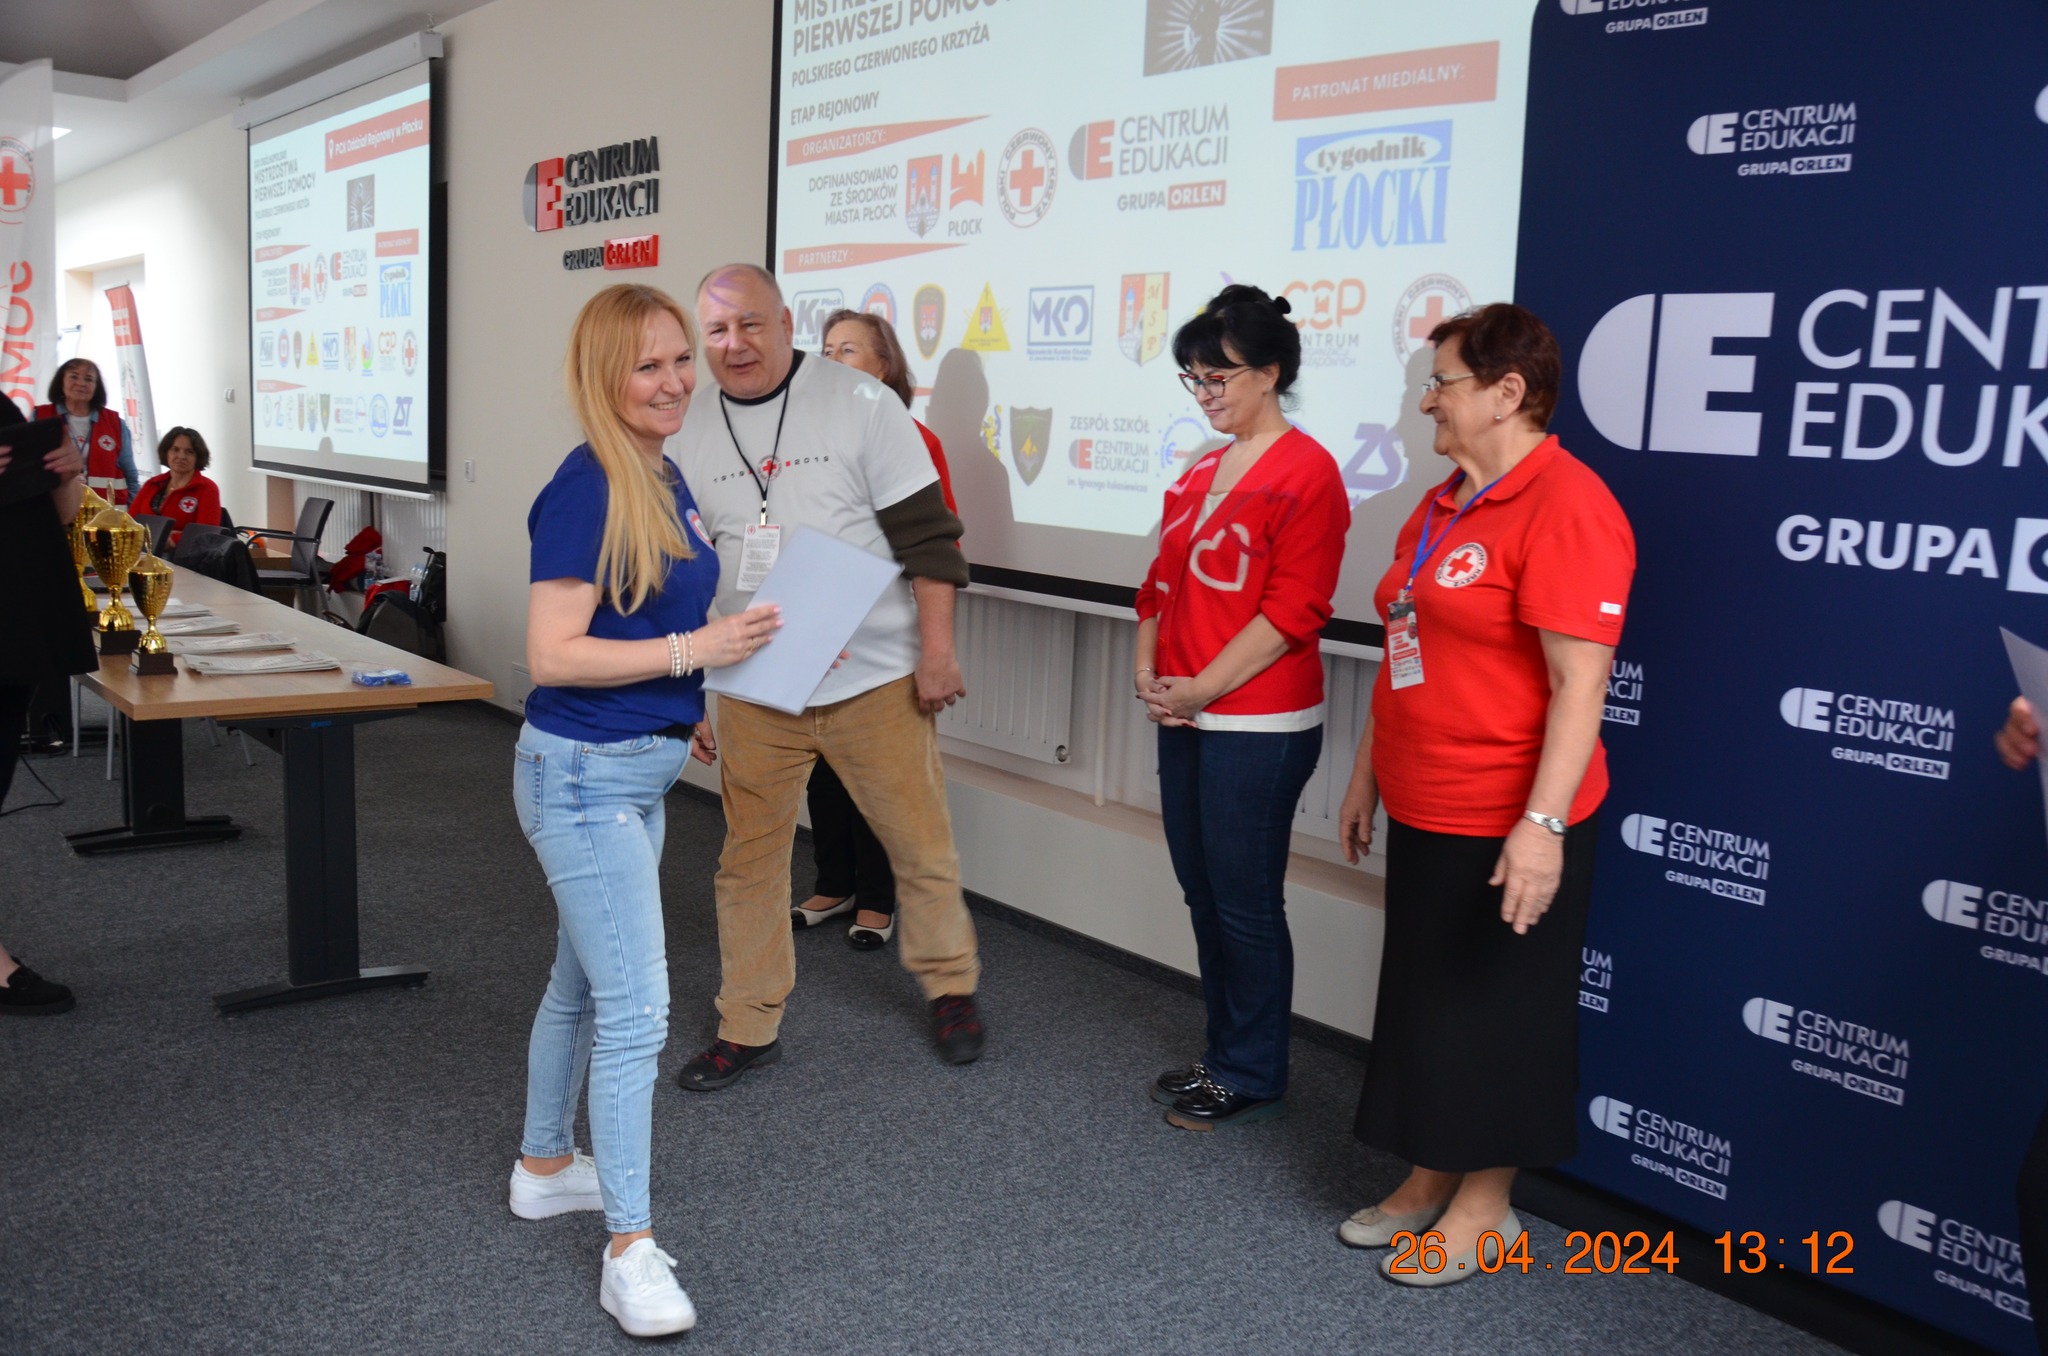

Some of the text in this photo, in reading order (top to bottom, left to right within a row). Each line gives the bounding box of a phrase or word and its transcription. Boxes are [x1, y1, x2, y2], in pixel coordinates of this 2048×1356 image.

[793, 1, 903, 57] PIERWSZEJ
[1605, 11, 1703, 33] GRUPA ORLEN
[791, 21, 991, 88] POLSKIEGO CZERWONEGO KRZYŻA
[1292, 63, 1465, 102] PATRONAT MIEDIALNY:
[790, 91, 880, 127] ETAP REJONOWY
[1120, 104, 1230, 146] CENTRUM
[1742, 102, 1857, 131] CENTRUM
[802, 129, 886, 158] ORGANIZATORZY:
[1119, 135, 1229, 176] EDUKACJI
[1317, 135, 1426, 173] tygodnik
[1740, 123, 1856, 153] EDUKACJI
[564, 135, 660, 187] CENTRUM
[808, 165, 899, 192] DOFINANSOWANO
[1738, 156, 1847, 176] GRUPA ORLEN
[563, 178, 660, 227] EDUKACJI
[830, 183, 898, 207] ZE ŚRODKÓW
[1117, 184, 1223, 211] GRUPA ORLEN
[1291, 166, 1452, 251] PŁOCKI
[825, 203, 897, 226] MIASTA PŁOCK
[947, 218, 983, 237] PŁOCK
[563, 239, 651, 270] GRUPA ORLEN
[1031, 294, 1090, 337] MKO
[1070, 413, 1151, 434] ZESPÓŁ SZKÓŁ
[1094, 456, 1149, 474] EDUKACJI
[1095, 440, 1149, 457] CENTRUM
[1776, 514, 2000, 579] GRUPA
[1837, 693, 1955, 729] CENTRUM
[1834, 714, 1954, 752] EDUKACJI
[1831, 746, 1944, 776] GRUPA ORLEN
[1669, 821, 1771, 861] CENTRUM
[1667, 841, 1770, 881] EDUKACJI
[1665, 870, 1762, 903] GRUPA ORLEN
[1980, 945, 2042, 971] GRUPA
[1796, 1009, 1910, 1060] CENTRUM
[1794, 1028, 1909, 1080] EDUKACJI
[1791, 1059, 1900, 1102] GRUPA ORLEN
[1635, 1108, 1732, 1158] CENTRUM
[1633, 1127, 1731, 1177] EDUKACJI
[1631, 1153, 1724, 1196] GRUPA ORLEN
[1933, 1269, 1994, 1303] GRUPA
